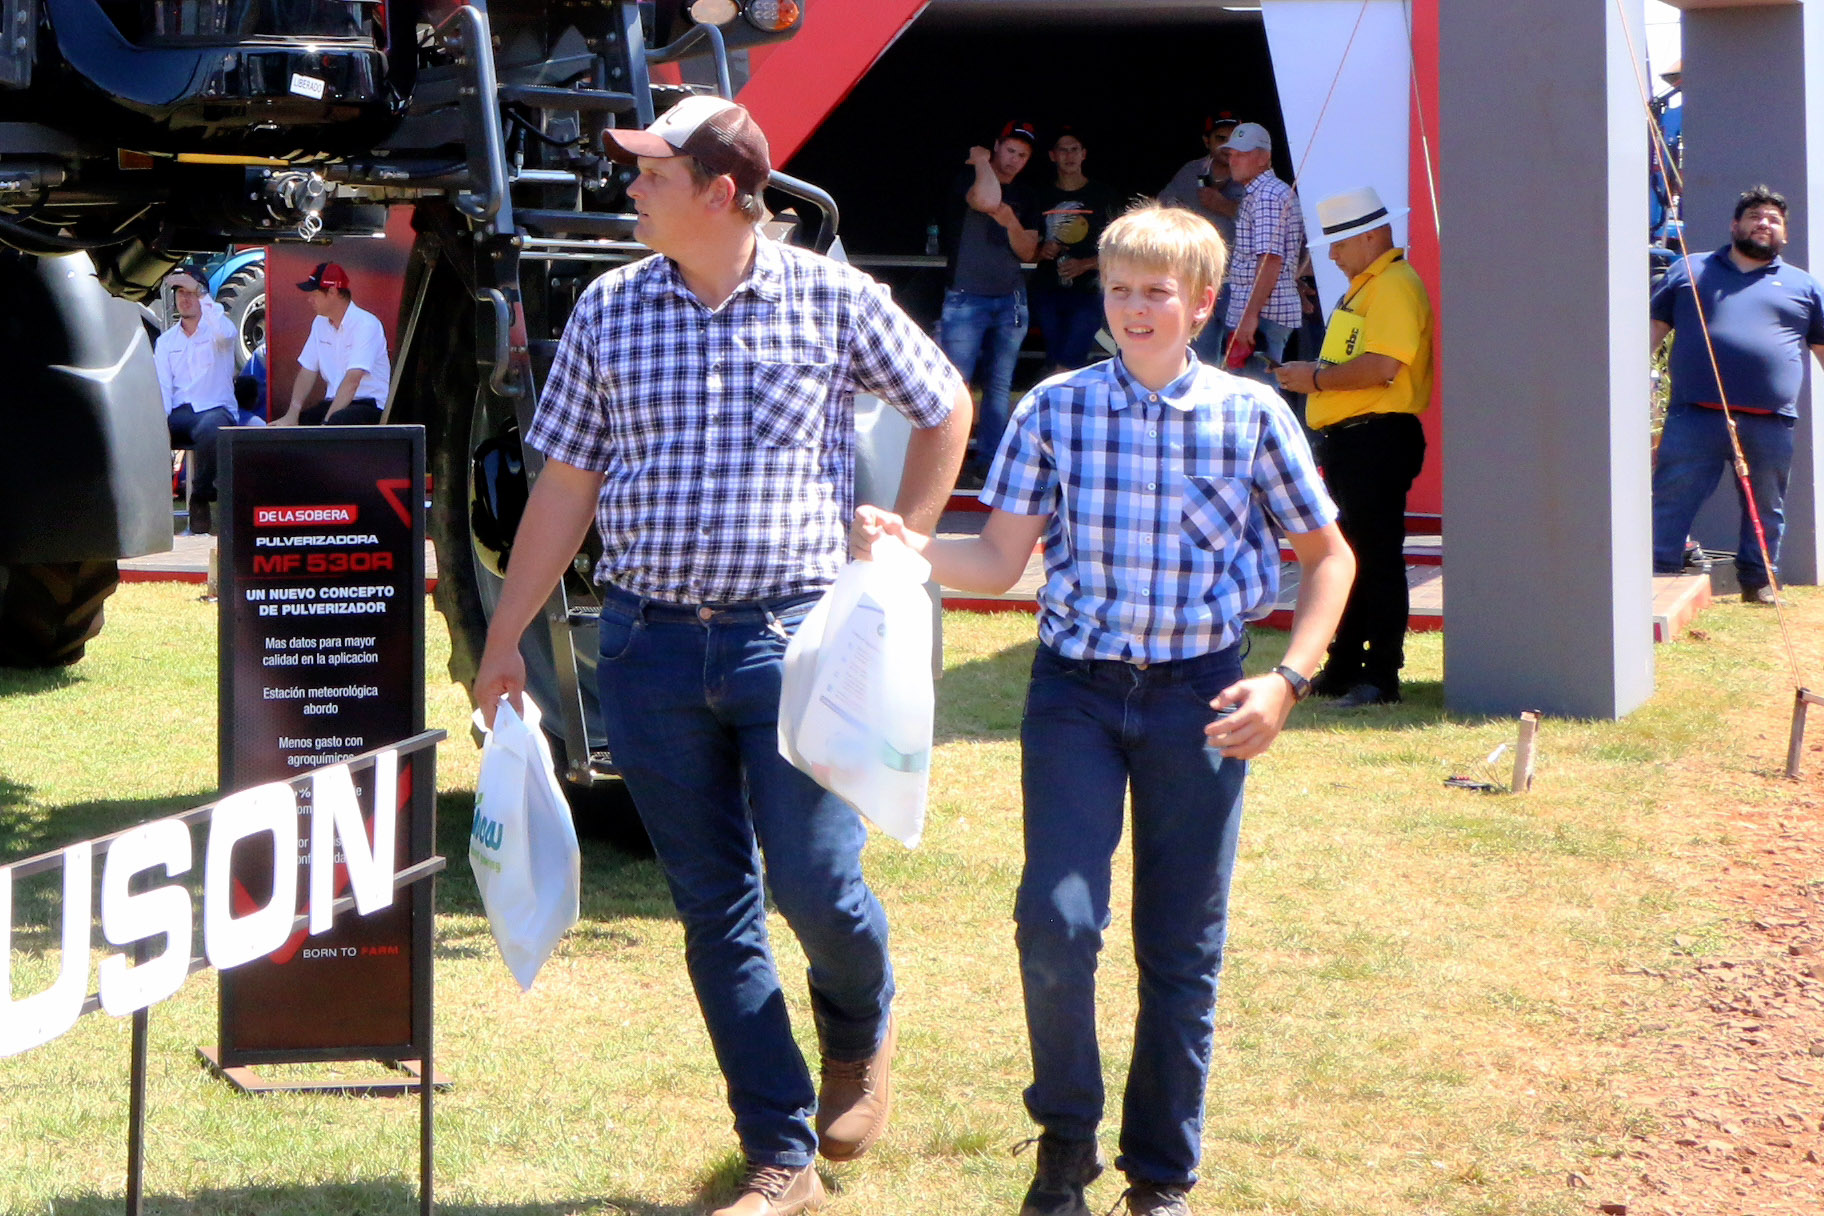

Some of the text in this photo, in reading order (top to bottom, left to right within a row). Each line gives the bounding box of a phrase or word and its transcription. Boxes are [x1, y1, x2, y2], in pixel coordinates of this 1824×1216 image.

[1345, 327, 1359, 356] abc
[256, 535, 378, 547] PULVERIZADORA
[253, 551, 393, 574] MF 530R
[246, 585, 394, 601] UN NUEVO CONCEPTO
[259, 601, 386, 616] DE PULVERIZADOR
[265, 636, 376, 650] Mas datos para mayor
[263, 651, 378, 666] calidad en la aplicacion
[263, 685, 378, 700] Estación meteorológica
[303, 703, 338, 715] abordo
[279, 736, 363, 750] Menos gasto con
[303, 945, 399, 959] BORN TO FARM
